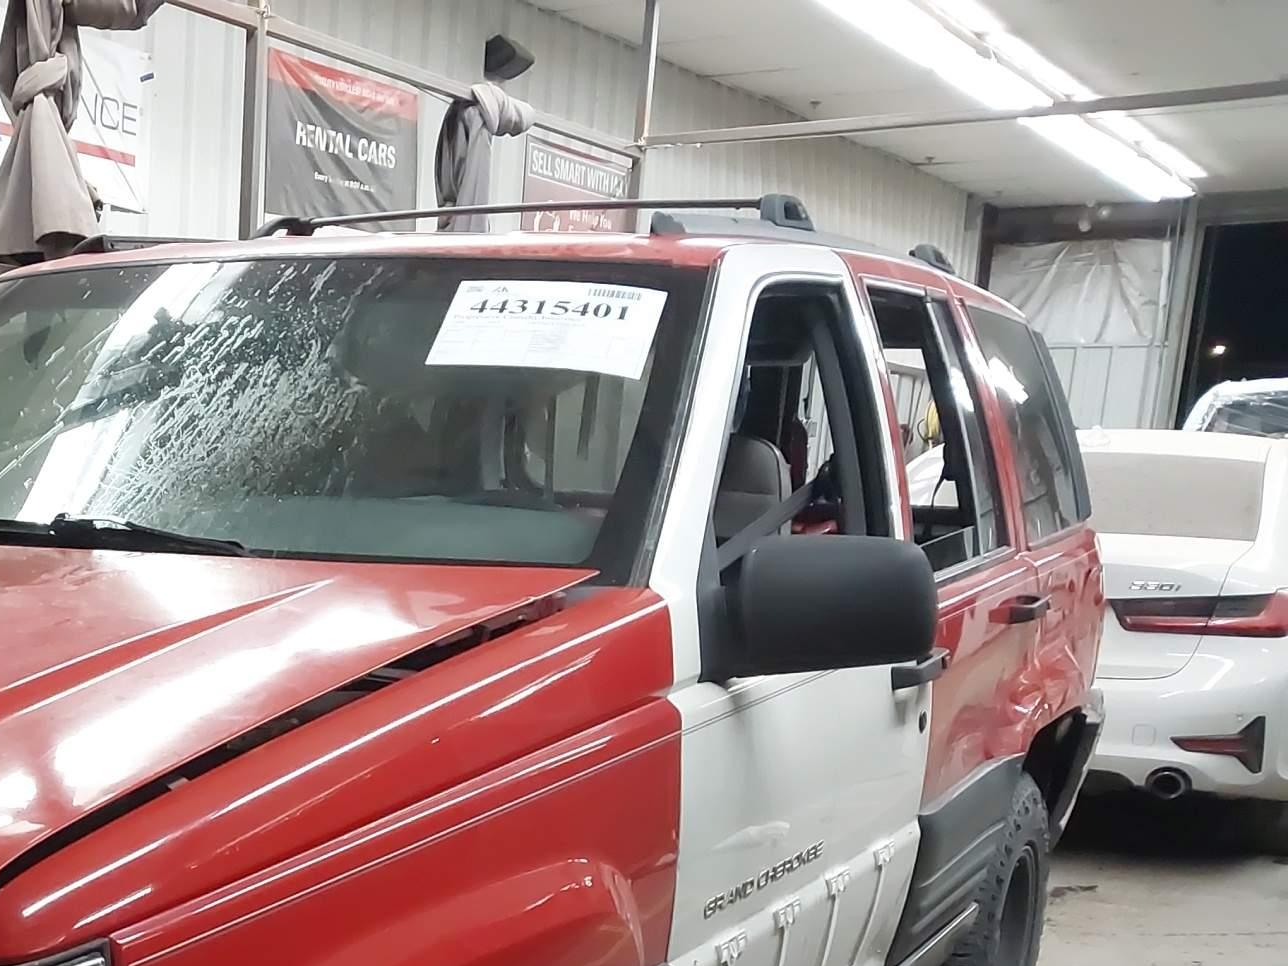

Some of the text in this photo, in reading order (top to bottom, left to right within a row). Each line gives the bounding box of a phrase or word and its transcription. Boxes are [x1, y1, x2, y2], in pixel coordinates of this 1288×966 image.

[296, 120, 396, 169] RENTAL CARS
[532, 149, 553, 176] SELL
[554, 156, 586, 186] SMART
[587, 166, 610, 194] WITH
[470, 299, 629, 321] 44315401
[704, 838, 825, 920] GRAND CHEROKEE
